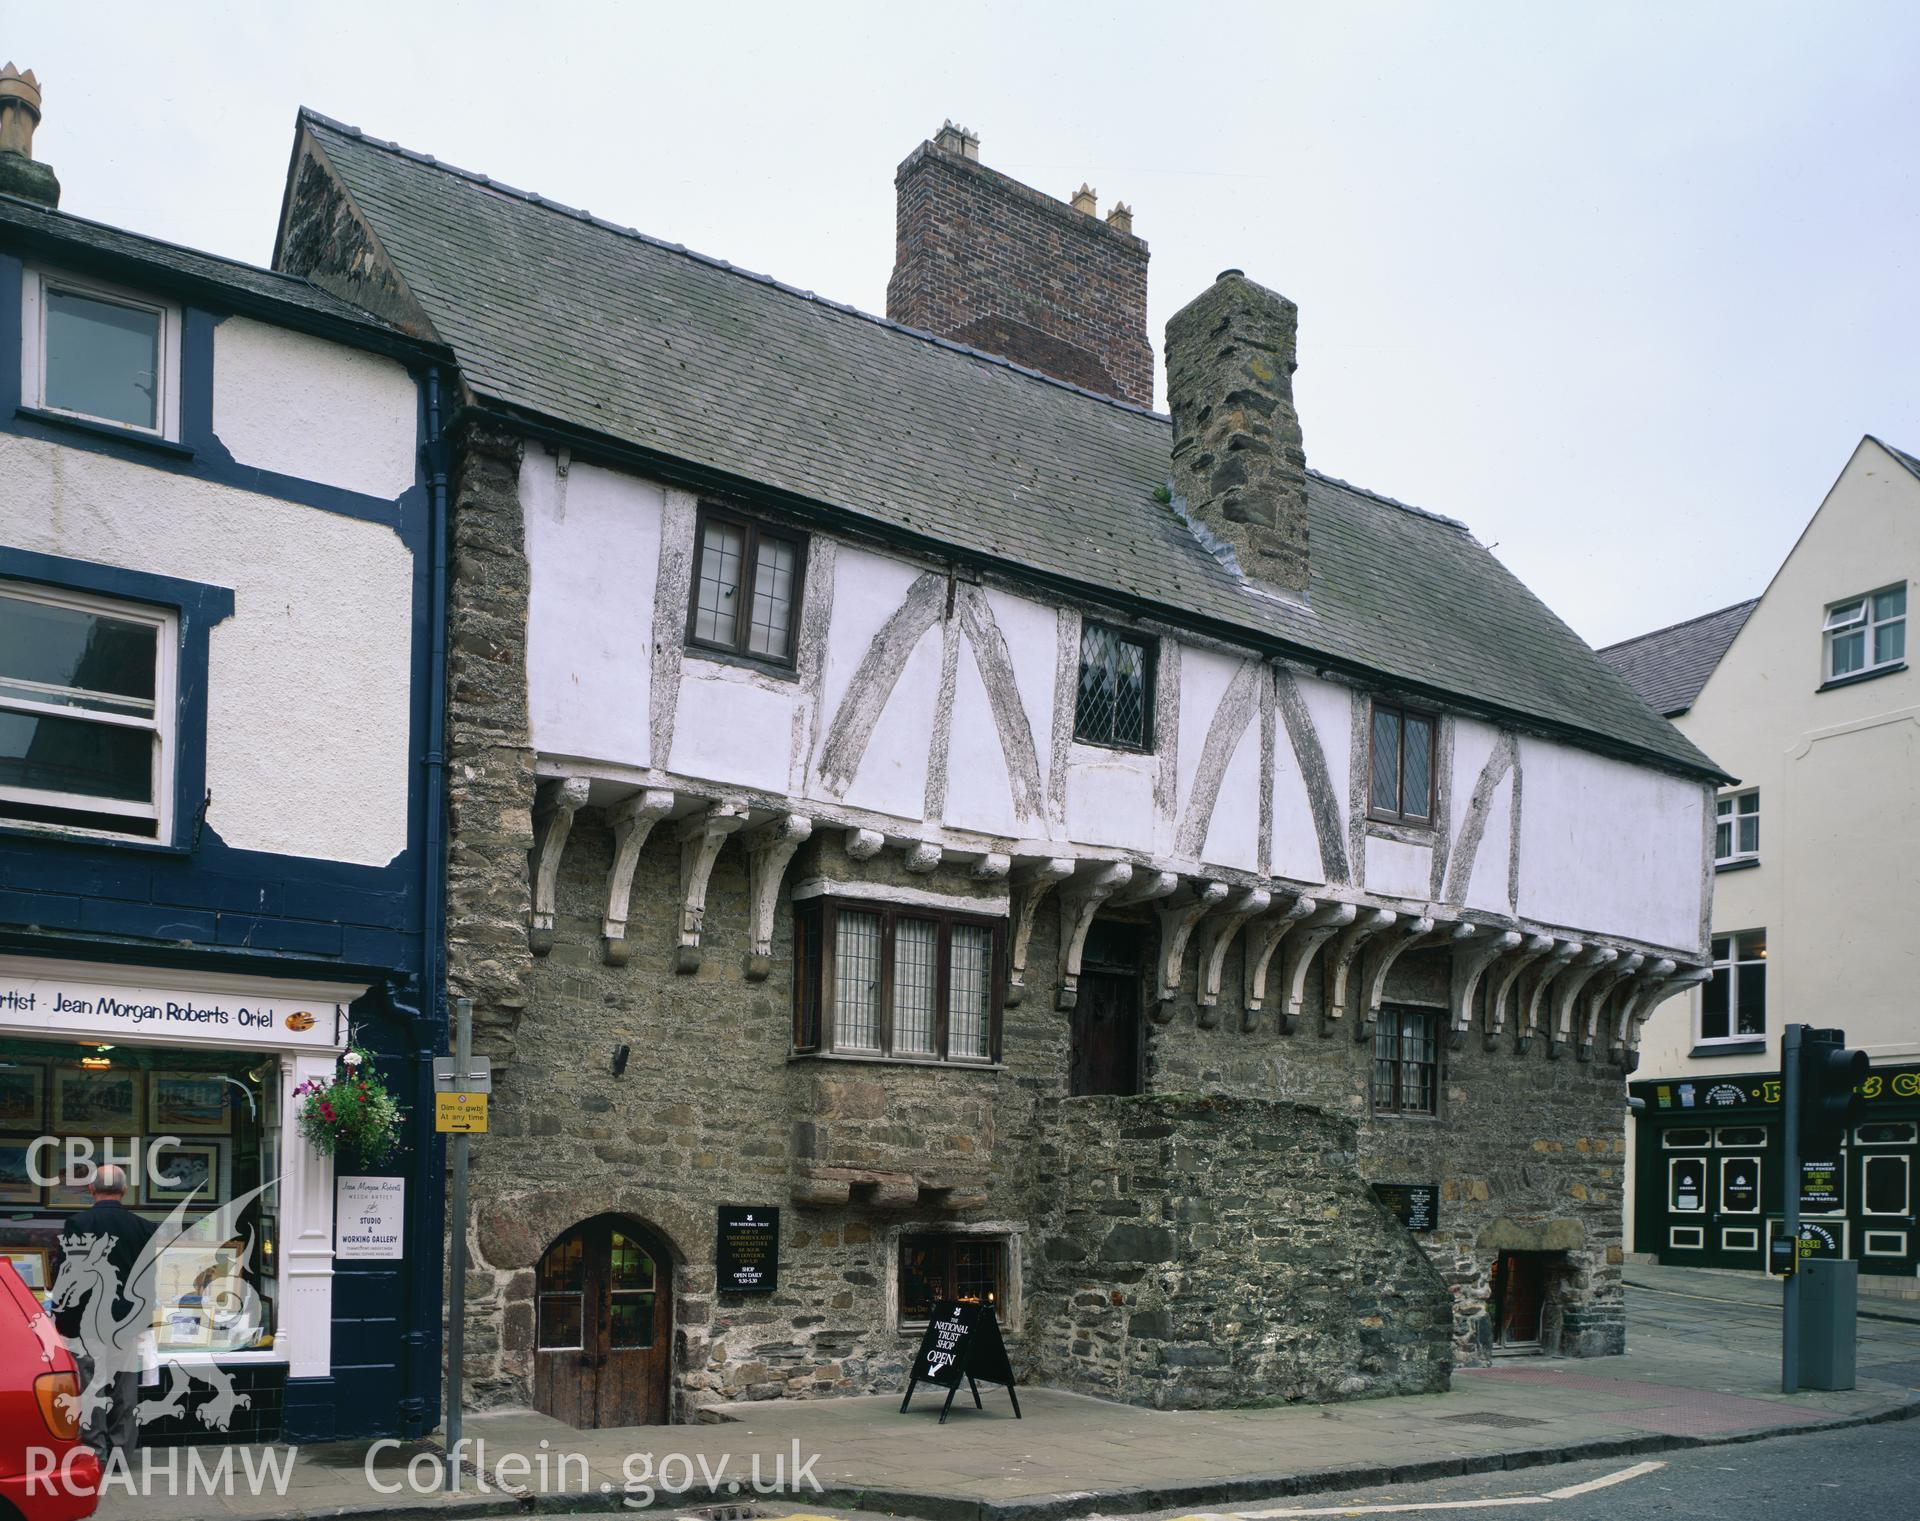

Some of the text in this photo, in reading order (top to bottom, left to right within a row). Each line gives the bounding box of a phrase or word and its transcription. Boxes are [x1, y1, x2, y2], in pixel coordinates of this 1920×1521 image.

[53, 992, 93, 1014] Jean
[96, 997, 162, 1023] Morgan
[167, 1002, 229, 1024] Roberts
[238, 1007, 273, 1030] Oriel
[1721, 1084, 1747, 1102] WINNING
[1799, 1239, 1821, 1248] ISH
[1803, 1224, 1836, 1249] WINNING
[934, 1321, 969, 1334] NATIONAL
[938, 1331, 961, 1342] TRUST
[936, 1340, 955, 1350] SHOP
[927, 1350, 956, 1366] OPEN
